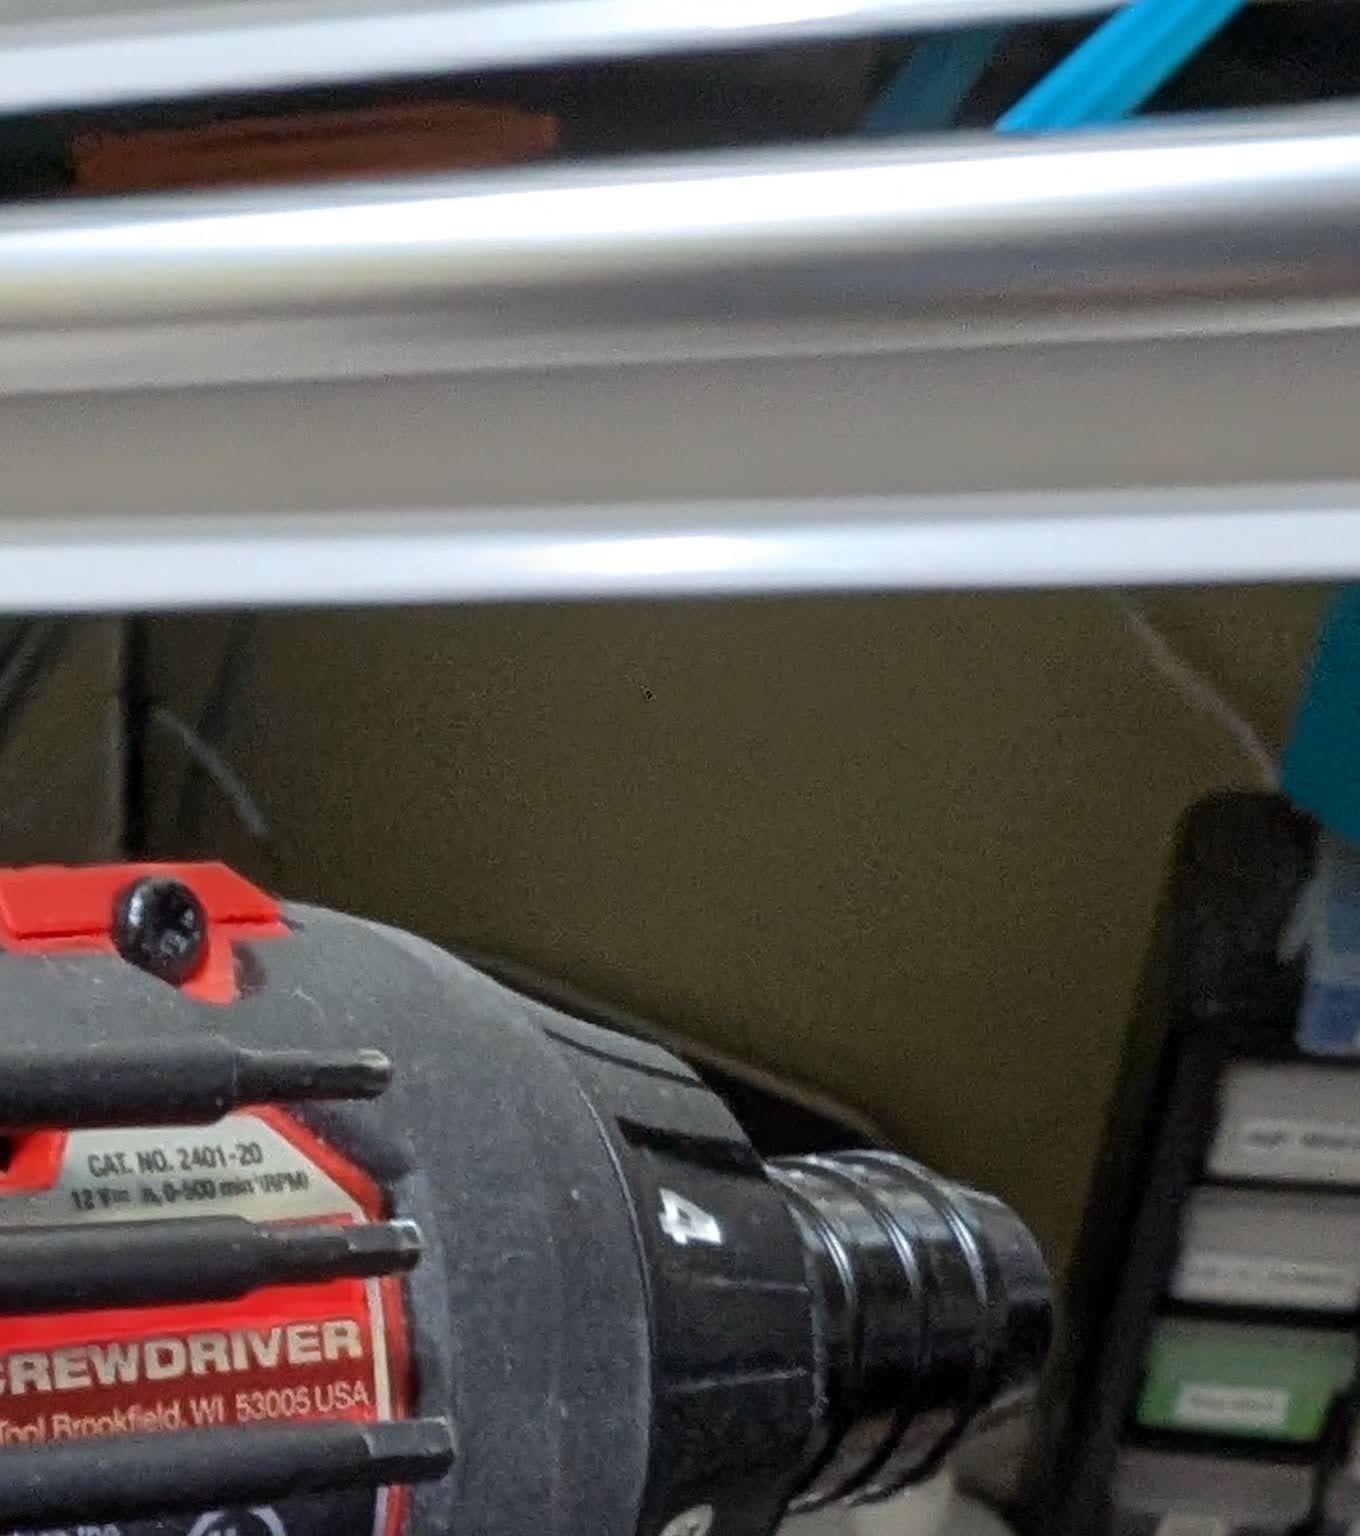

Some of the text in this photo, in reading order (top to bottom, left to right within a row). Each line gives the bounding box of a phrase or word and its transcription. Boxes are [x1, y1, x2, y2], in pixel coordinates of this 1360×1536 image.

[136, 1149, 174, 1174] NO.
[178, 1140, 265, 1171] 2401-20
[191, 1392, 225, 1426] WI
[314, 1379, 370, 1413] USA
